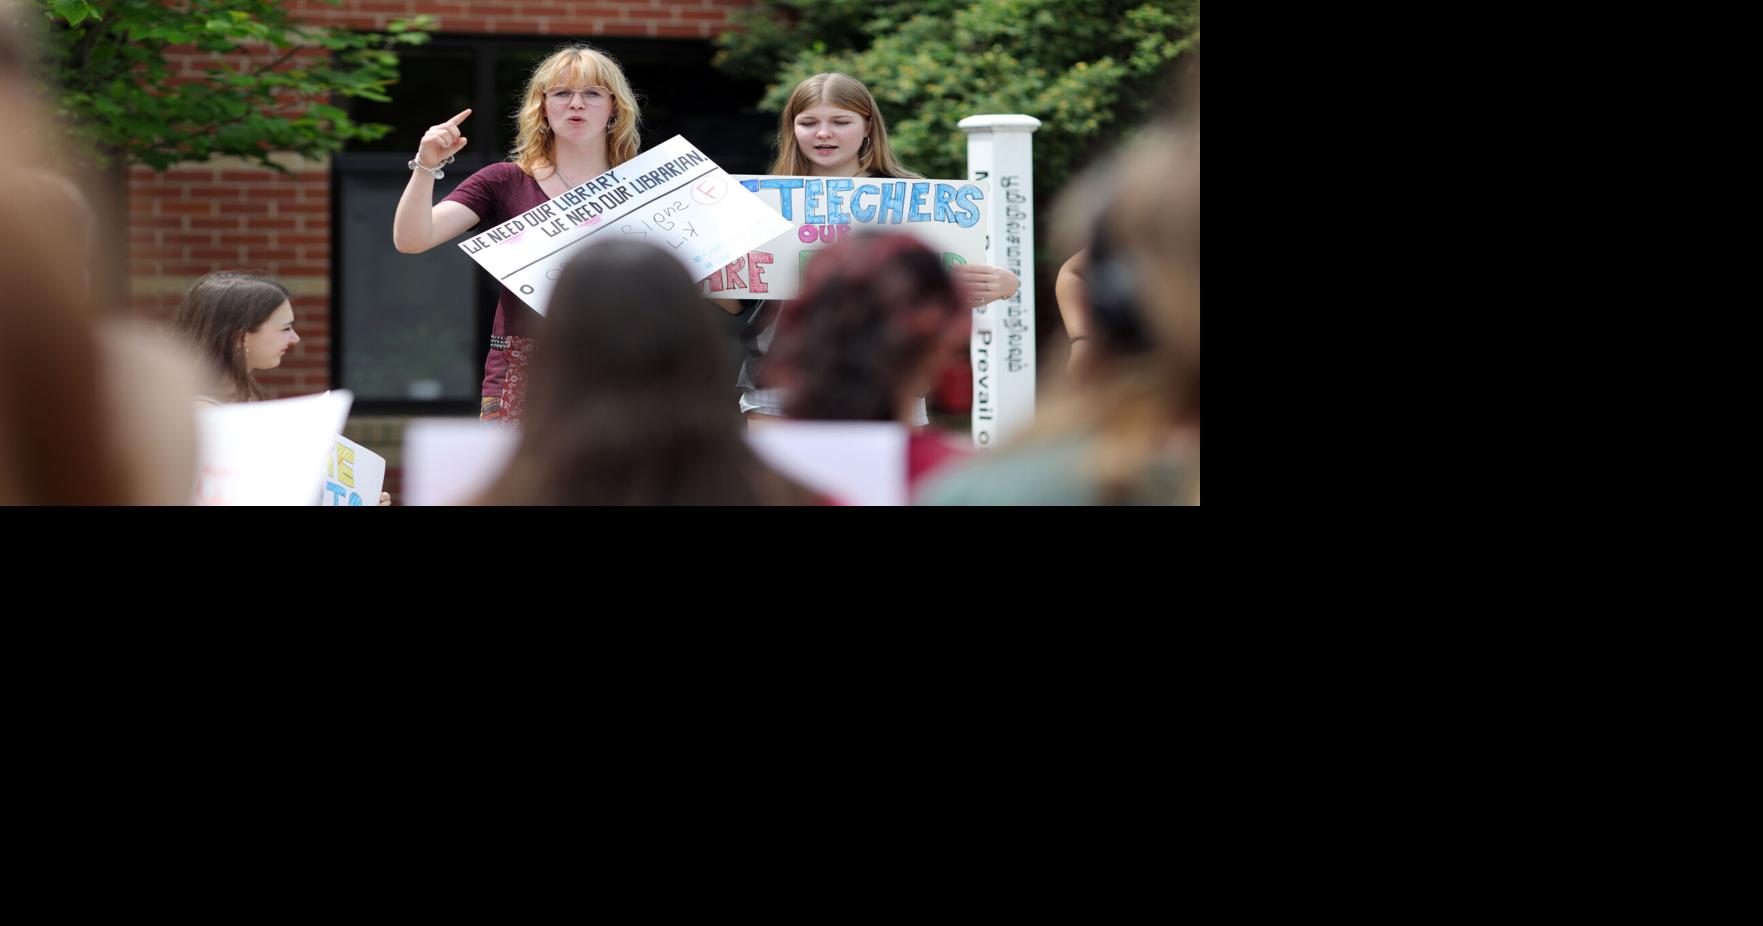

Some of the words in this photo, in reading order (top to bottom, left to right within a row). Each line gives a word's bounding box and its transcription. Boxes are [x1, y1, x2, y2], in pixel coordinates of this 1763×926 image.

[463, 236, 490, 254] WE
[487, 220, 525, 243] NEED
[523, 203, 557, 227] OUR
[552, 170, 626, 211] LIBRARY.
[541, 218, 570, 237] WE
[566, 201, 603, 226] NEED
[598, 185, 634, 210] OUR
[629, 150, 708, 194] LIBRARIAN.
[760, 178, 984, 228] TEECHERS
[977, 330, 993, 420] Prevail
